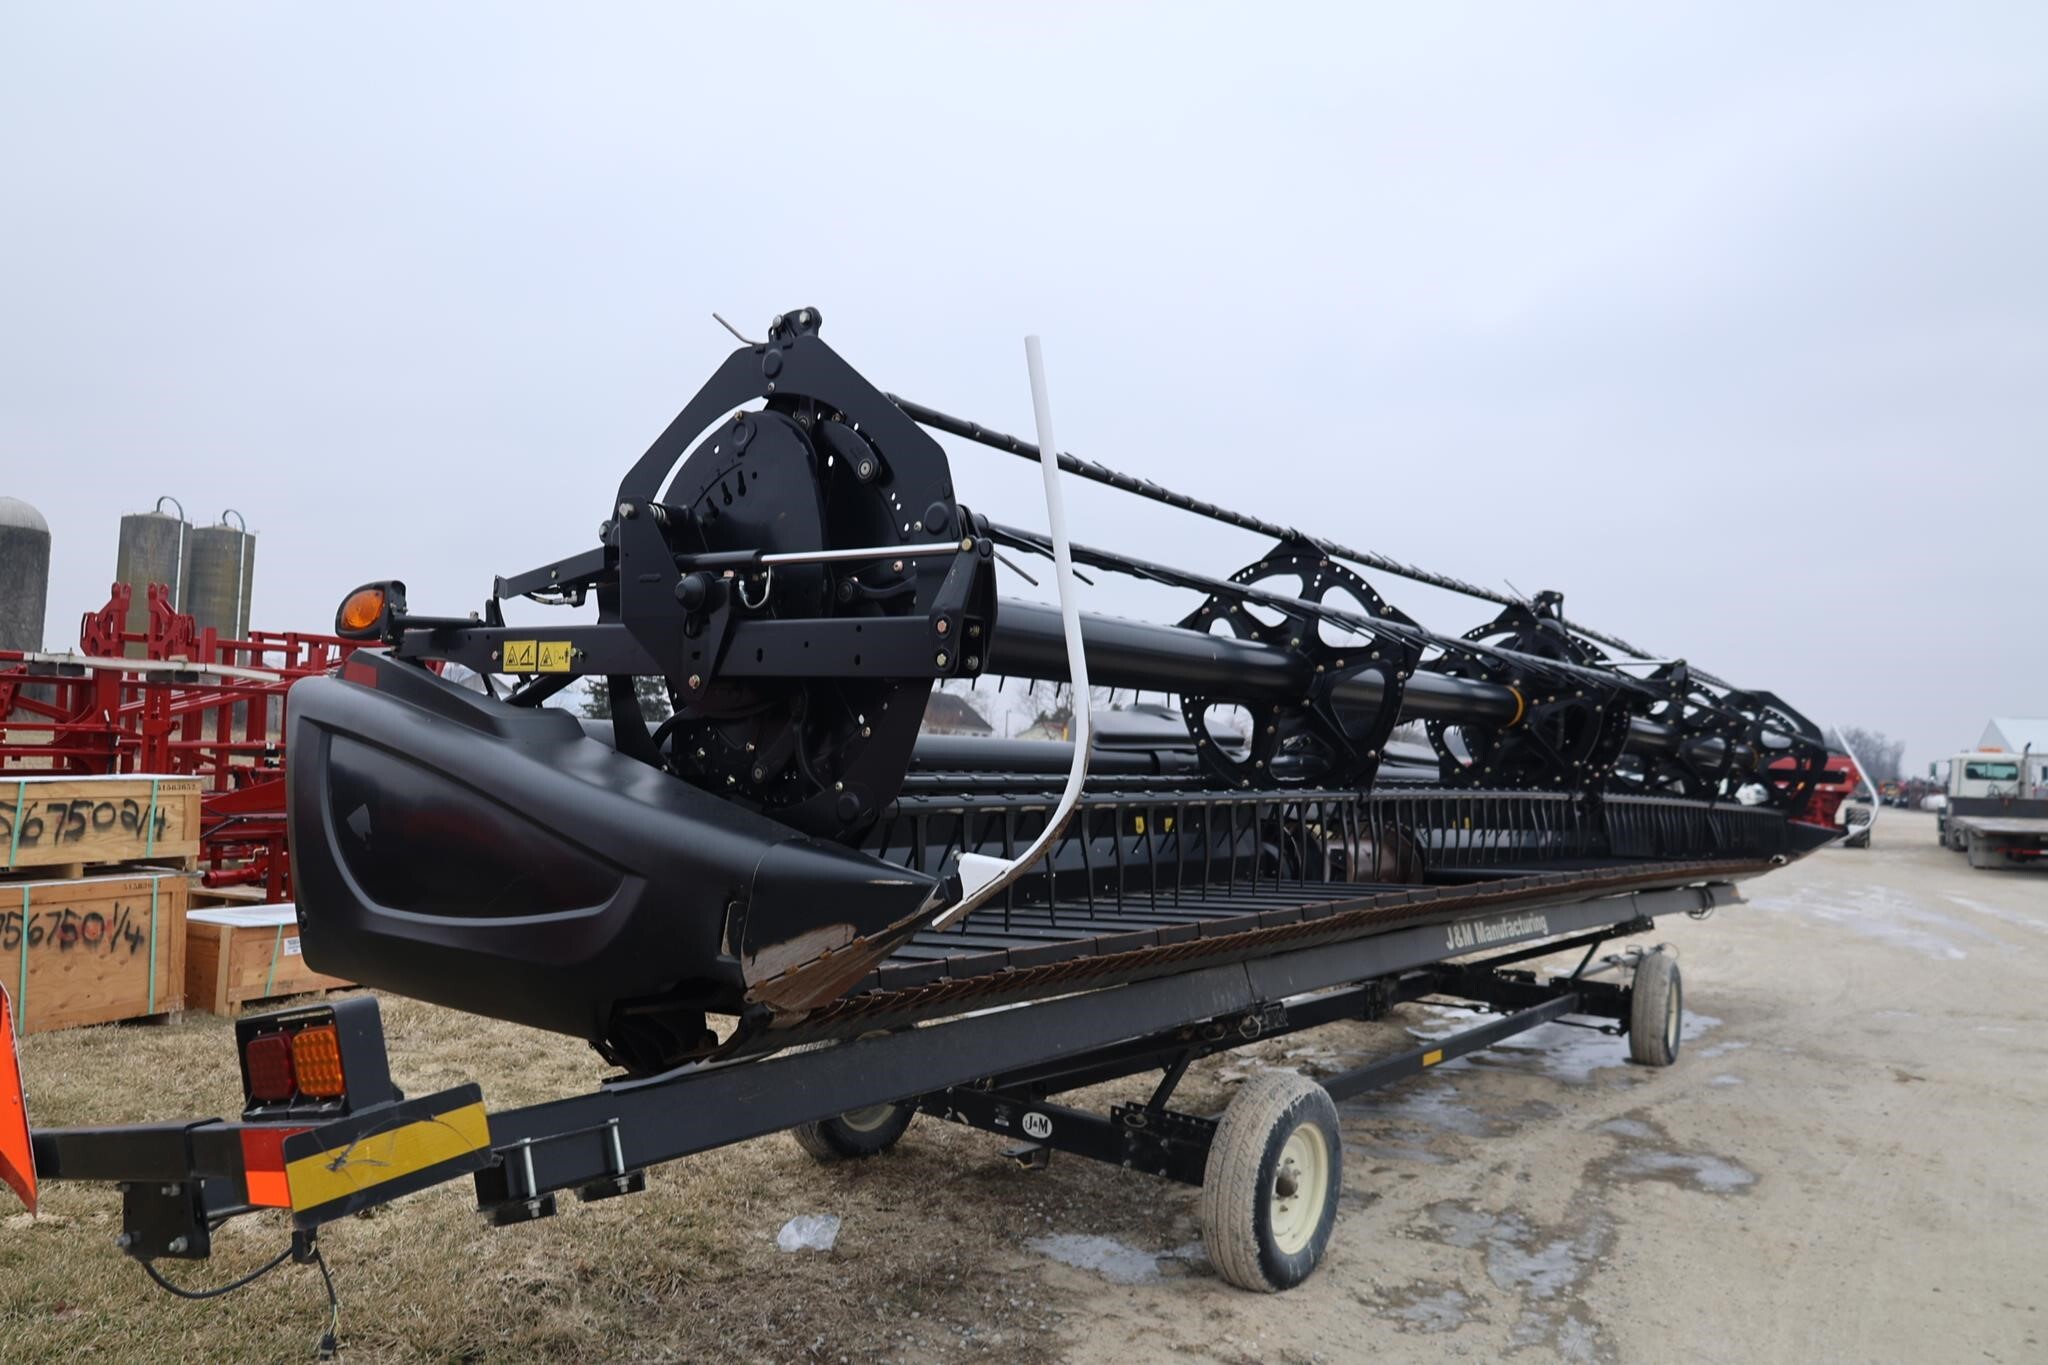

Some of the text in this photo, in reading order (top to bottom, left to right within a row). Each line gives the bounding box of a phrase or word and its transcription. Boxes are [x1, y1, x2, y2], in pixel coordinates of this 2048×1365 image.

[1446, 913, 1549, 950] J&M Manufacturing
[1025, 1115, 1048, 1134] J&M
